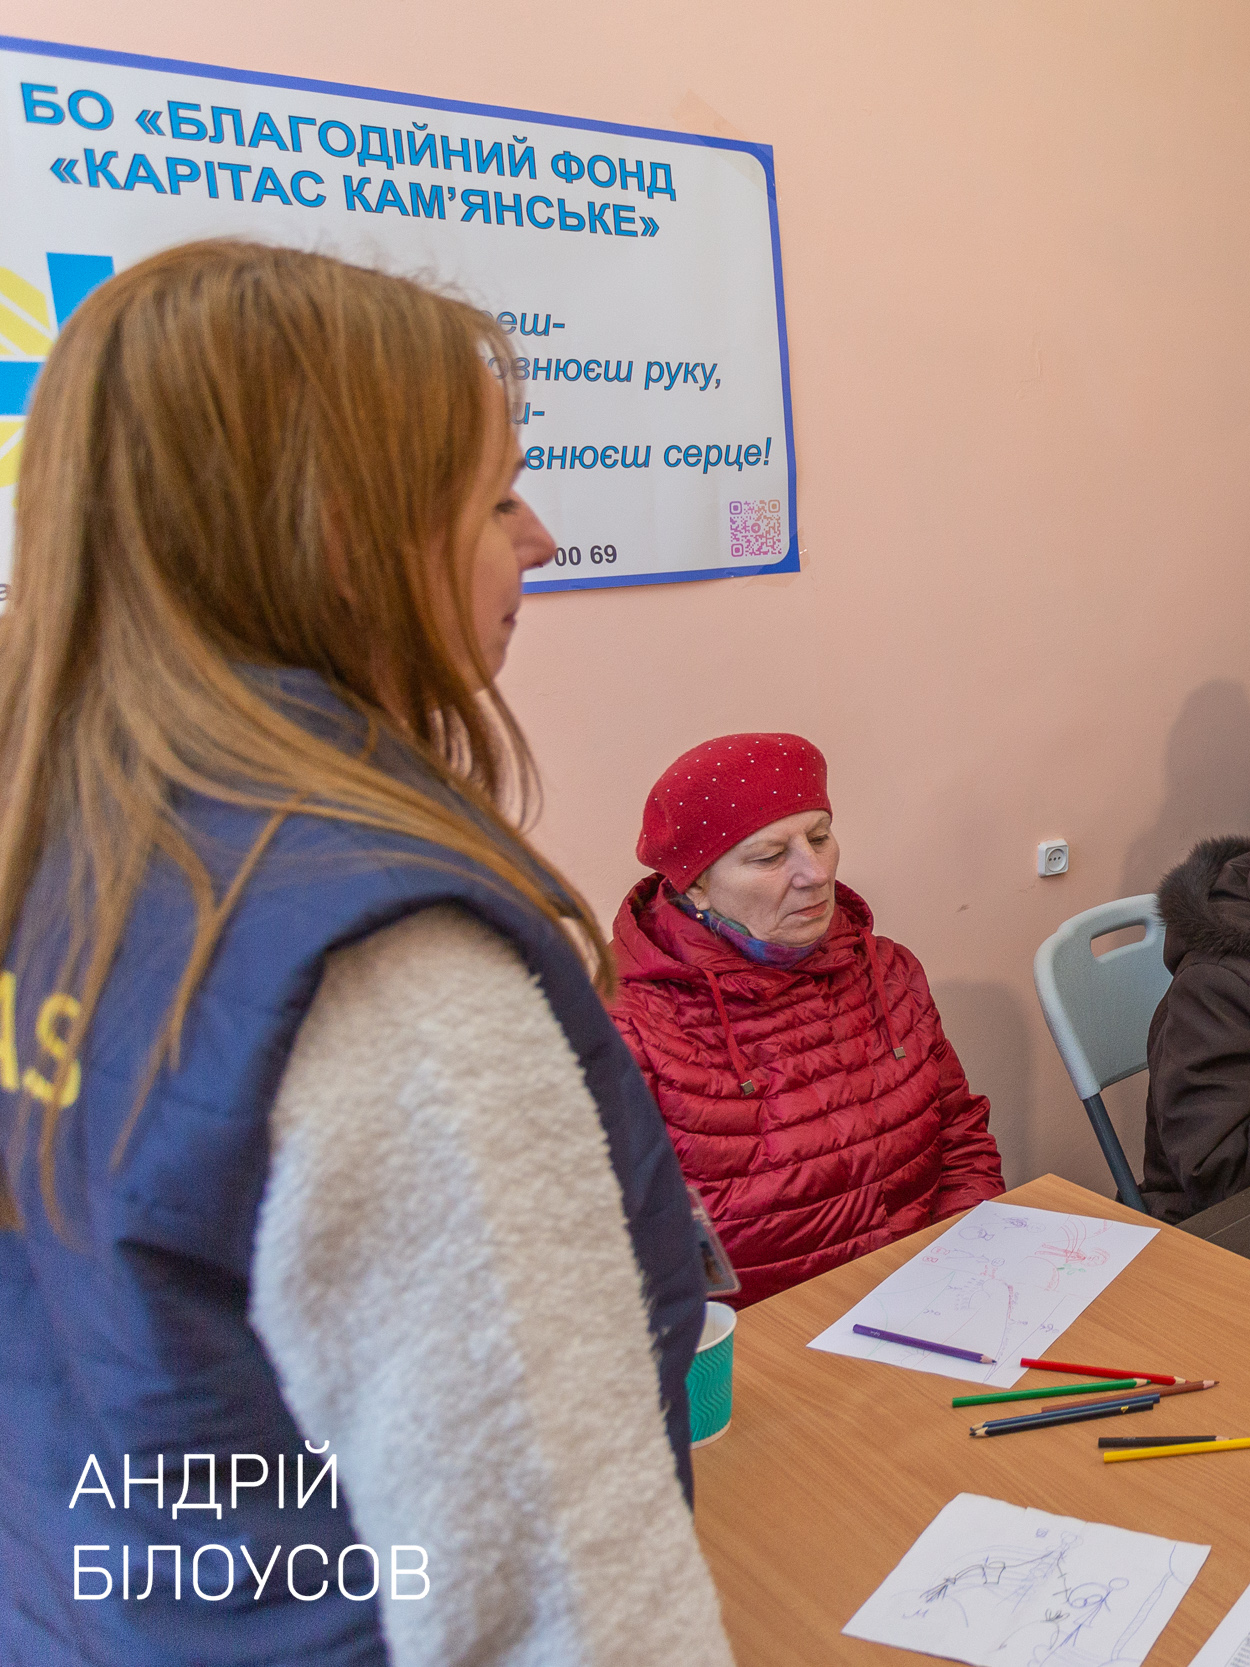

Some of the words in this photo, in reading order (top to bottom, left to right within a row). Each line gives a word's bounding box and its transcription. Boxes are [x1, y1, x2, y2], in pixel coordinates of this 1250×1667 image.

[20, 82, 114, 131] БО
[135, 100, 537, 180] «БЛАГОДІЙНИЙ
[551, 151, 677, 201] ФОНД
[50, 148, 326, 208] «КАРІТАС
[480, 356, 633, 383] овнюєш
[644, 361, 721, 391] руку,
[525, 445, 651, 471] внюєш
[664, 437, 772, 475] серце!
[590, 544, 617, 564] 69
